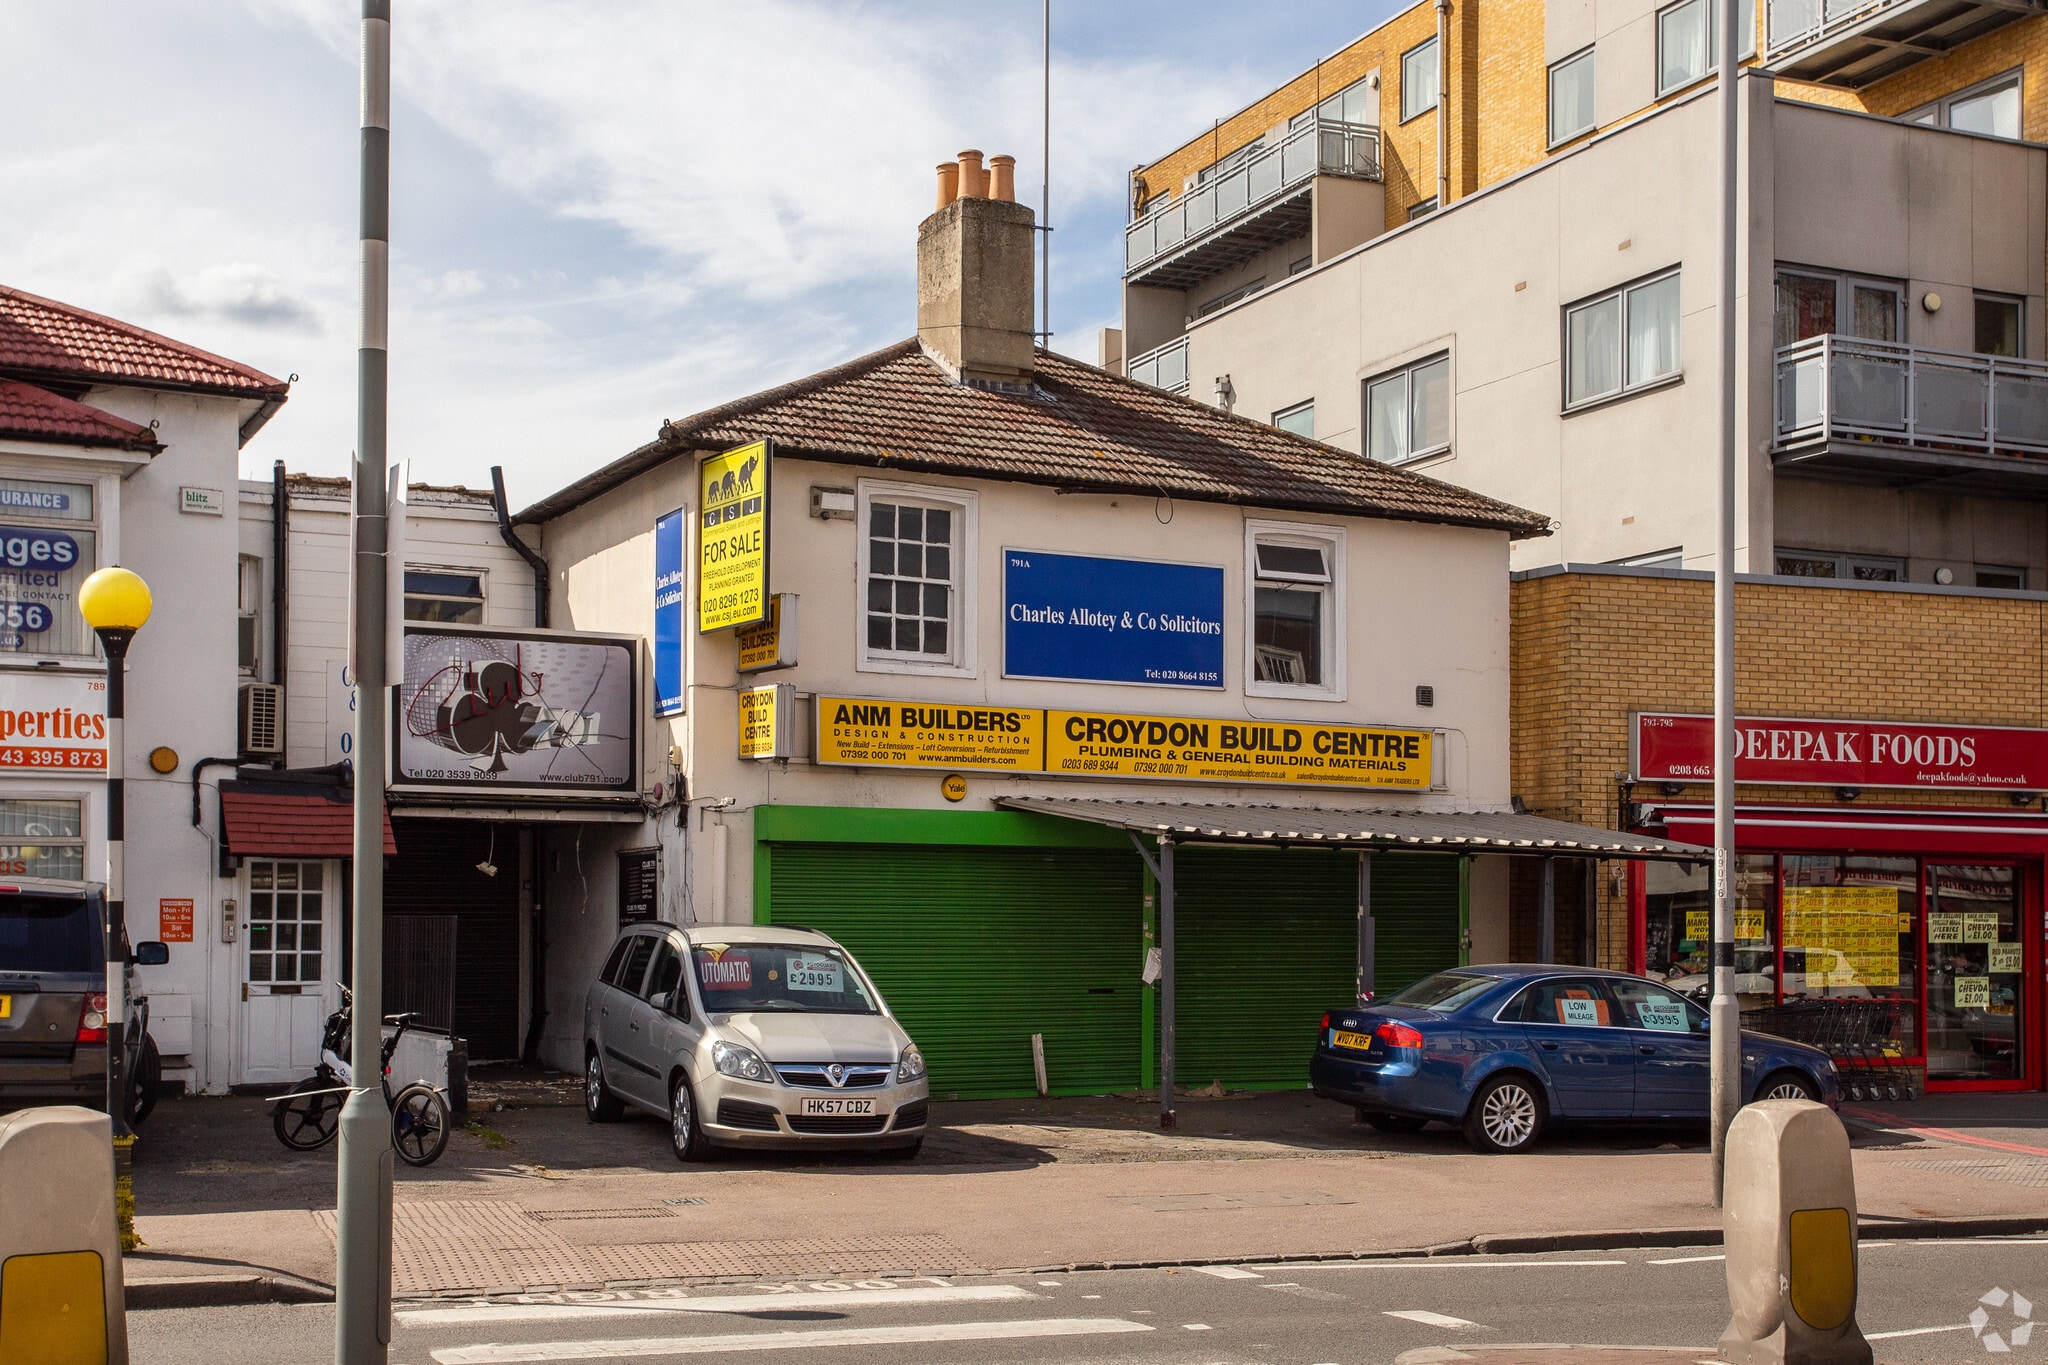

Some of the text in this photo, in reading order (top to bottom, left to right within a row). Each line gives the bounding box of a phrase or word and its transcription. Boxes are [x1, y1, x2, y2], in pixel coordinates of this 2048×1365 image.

[186, 491, 208, 502] blitz
[704, 530, 760, 566] FOR SALE
[704, 558, 760, 580] FREEHOLD DEVELOPMENT
[1011, 558, 1030, 568] 791A
[709, 572, 754, 590] PLANNING GRANTED
[23, 591, 71, 600] CONTACT
[704, 588, 758, 613] 020 8296 1273
[705, 606, 756, 624] www.csj.eu.com
[1010, 603, 1220, 635] Charles Allotey & Co Solicitors
[742, 632, 774, 650] BUILDERS
[1144, 669, 1218, 681] Tel: 020 8664 8155
[87, 682, 106, 691] 789
[742, 692, 774, 708] CROYDON
[748, 710, 768, 724] BUILD
[834, 704, 891, 727] ANM
[902, 708, 1021, 732] BUILDERS
[1642, 718, 1674, 728] 793-795
[745, 725, 770, 740] CENTRE
[834, 728, 1030, 744] DESIGN & CONSTRUCTION
[1065, 716, 1420, 759] CROYDON BUILD CENTRE
[836, 740, 852, 748] New
[878, 742, 914, 750] Extensions
[922, 744, 936, 752] Loft
[936, 744, 976, 754] Conversions
[983, 746, 1030, 756] Refurbishment
[1870, 733, 1976, 768] FOODS
[30, 750, 64, 765] 395
[70, 752, 102, 766] 873
[840, 750, 1016, 765] 07392 000 701 www.anmbuilders.com
[1078, 745, 1407, 772] PLUMBING & GENERAL BUILDING MATERIALS
[408, 768, 498, 780] Tel 020 3539 9059
[1062, 758, 1082, 770] 0203
[1083, 760, 1098, 770] 689
[1100, 760, 1119, 771] 9344
[1134, 762, 1158, 774] 07392
[1158, 762, 1174, 774] 000
[1174, 764, 1188, 775] 701
[1200, 768, 1286, 780] www.croydonbuildcentre.co.uk
[1296, 773, 1371, 784] sales@croydonbuildcentre.co.uk
[1669, 765, 1710, 776] 0208 665
[539, 774, 624, 784] www.club791.com
[1916, 771, 2027, 786] deepakfoods@yahoo.co.uk
[948, 783, 966, 793] Yale
[1968, 923, 1997, 932] CHEVDA
[1934, 932, 1958, 940] HERE
[1972, 931, 1993, 940] £1.00
[2002, 948, 2021, 956] PEANUTS
[1992, 956, 1997, 966] 2
[1958, 984, 1988, 992] CHEVDA
[1964, 994, 1984, 1003] £1.00
[1568, 1002, 1587, 1010] LOW
[1354, 1034, 1368, 1047] KRF
[808, 1100, 871, 1113] HK57 CDZ
